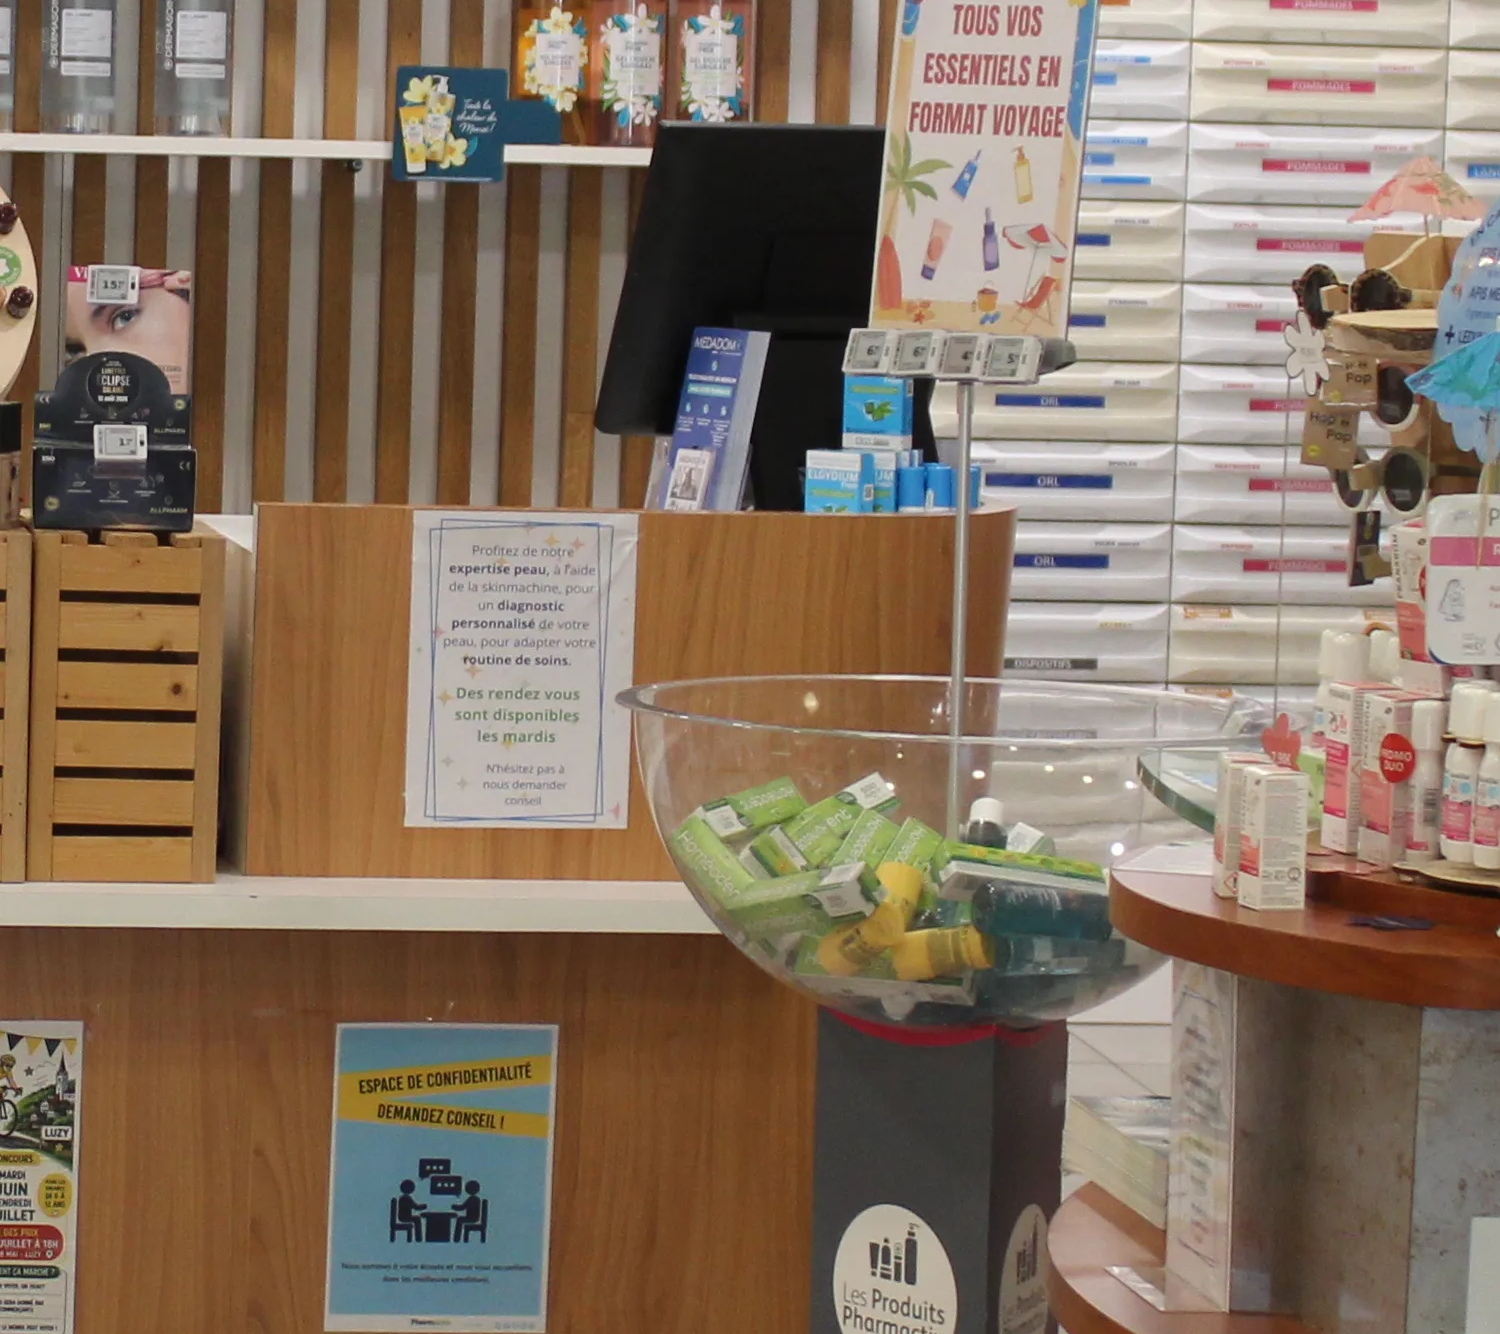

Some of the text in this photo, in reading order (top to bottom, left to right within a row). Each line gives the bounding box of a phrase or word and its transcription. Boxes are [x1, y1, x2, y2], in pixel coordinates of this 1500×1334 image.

[952, 4, 1045, 37] TOUS VOS
[923, 52, 1061, 87] ESSENTIELS EN
[908, 102, 1066, 138] FORMAT VOYAGE
[1037, 476, 1060, 486] ORL
[472, 545, 574, 557] Profitez de notre
[449, 564, 510, 577] expertise
[514, 565, 550, 577] peau,
[478, 600, 564, 614] un diagnostic
[452, 617, 590, 631] personnalisé de votre
[463, 653, 572, 667] routine de soins.
[456, 687, 581, 701] Des rendez vous
[455, 708, 580, 724] sont disponibles
[477, 730, 556, 743] les mardis
[359, 1062, 532, 1094] ESPACE DE CONFIDENTIALITÉ
[377, 1104, 496, 1129] DEMANDEZ CONSEIL
[44, 1128, 69, 1139] LUZY
[842, 1281, 944, 1325] Les Produits
